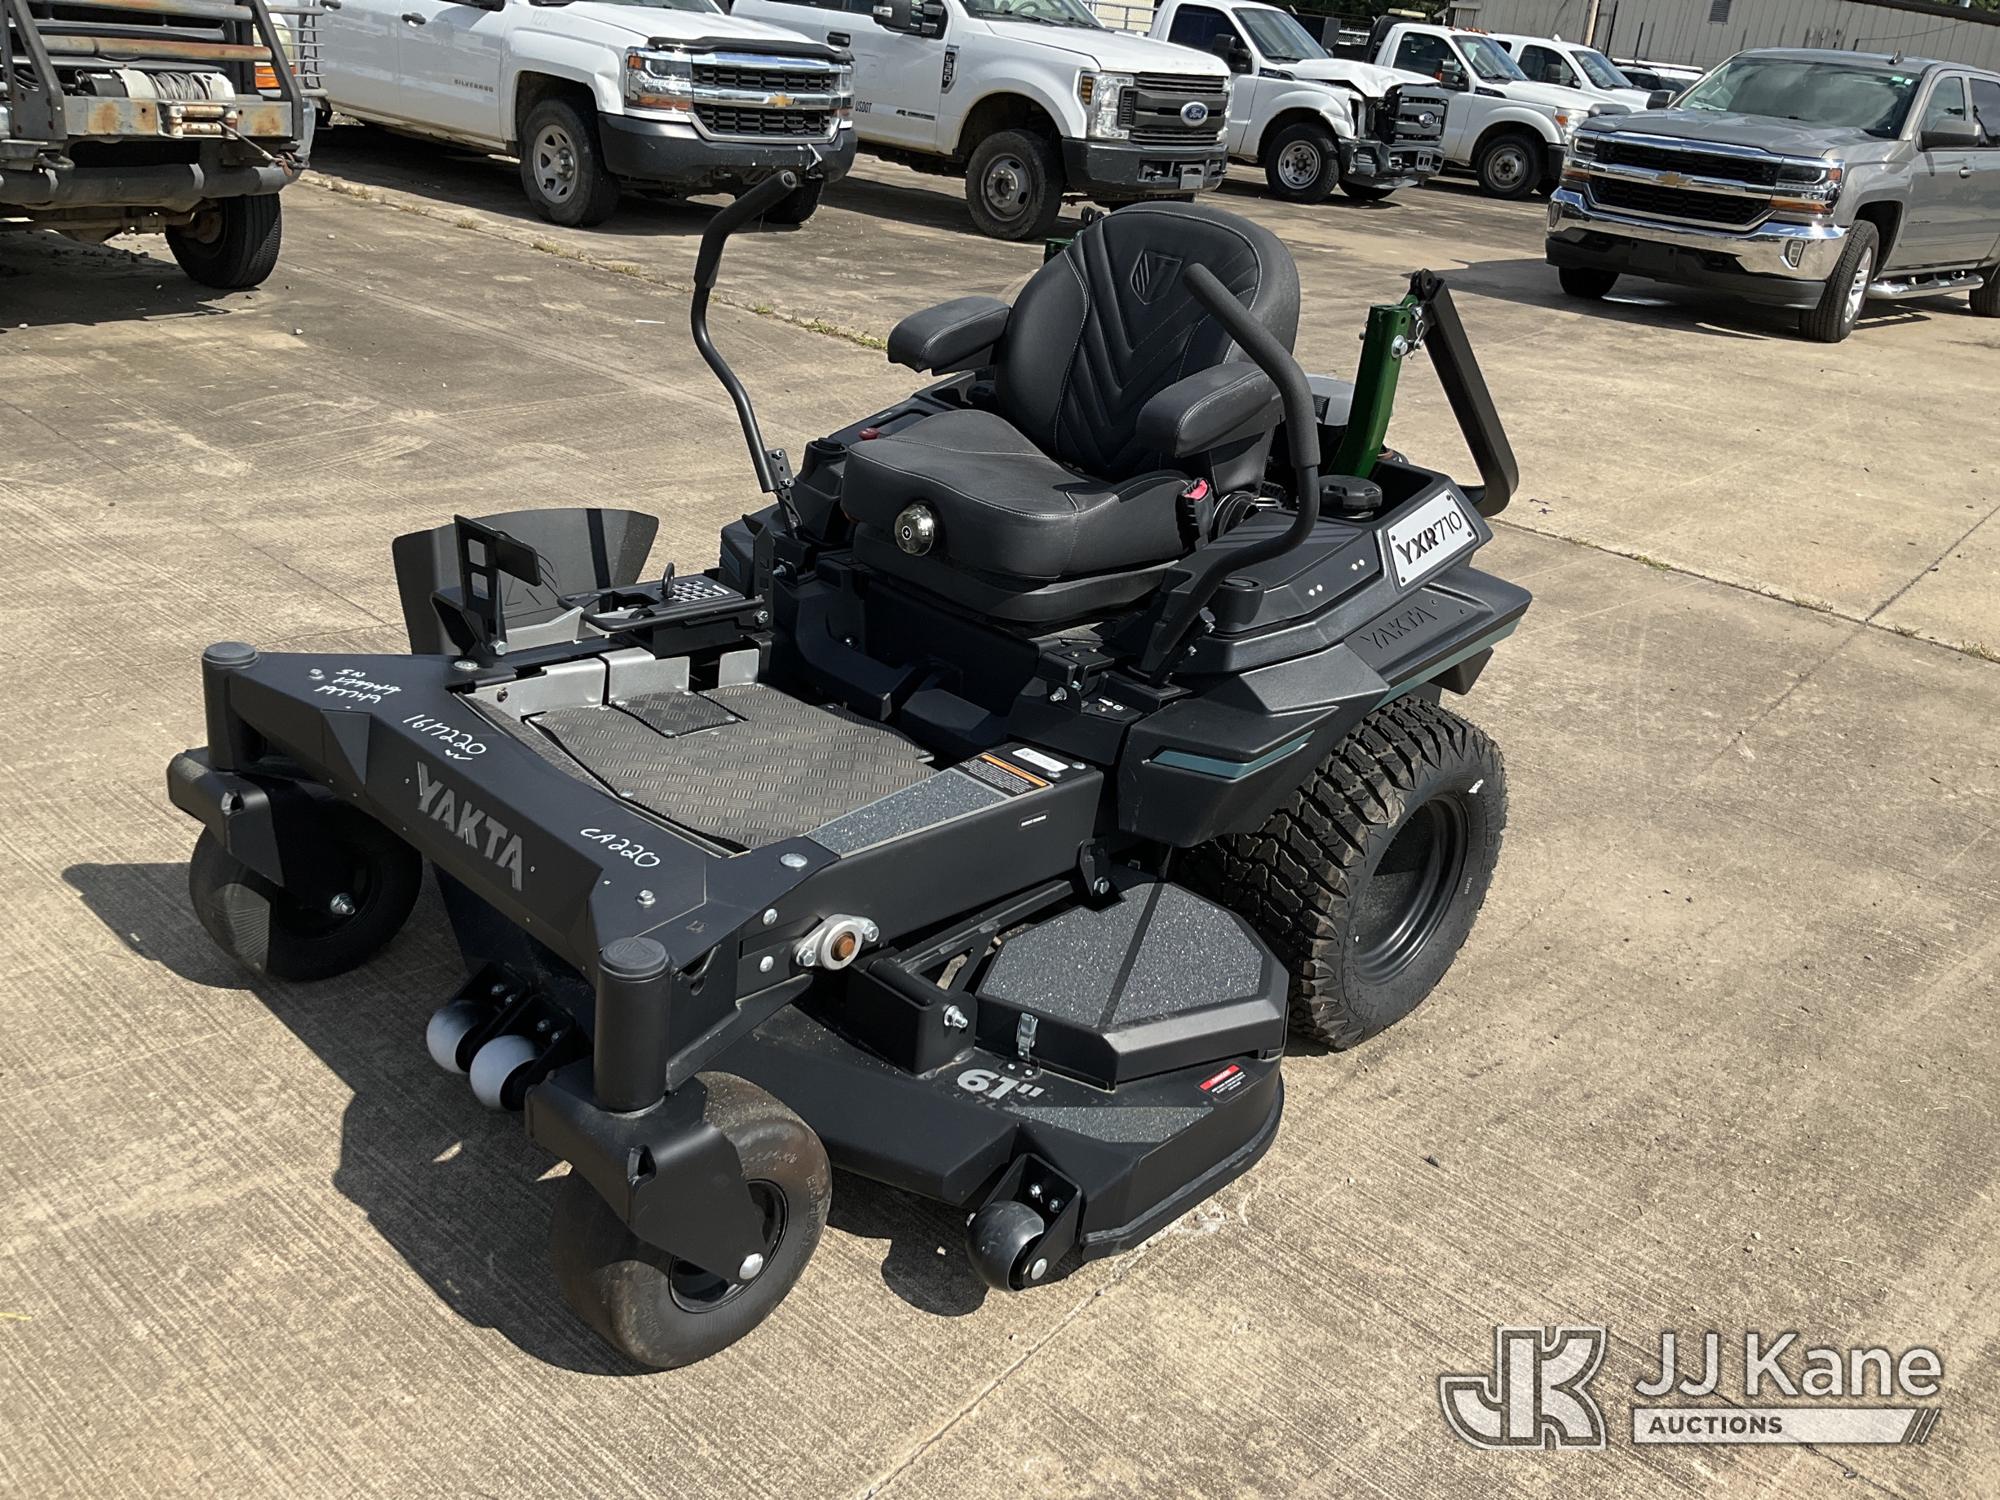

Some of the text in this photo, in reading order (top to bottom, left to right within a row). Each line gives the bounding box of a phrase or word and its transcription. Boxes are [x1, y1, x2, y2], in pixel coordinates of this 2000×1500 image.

[1395, 511, 1463, 566] YXR710
[1360, 606, 1438, 649] YAKTA
[417, 761, 523, 892] YAKTA
[580, 828, 661, 868] CA220
